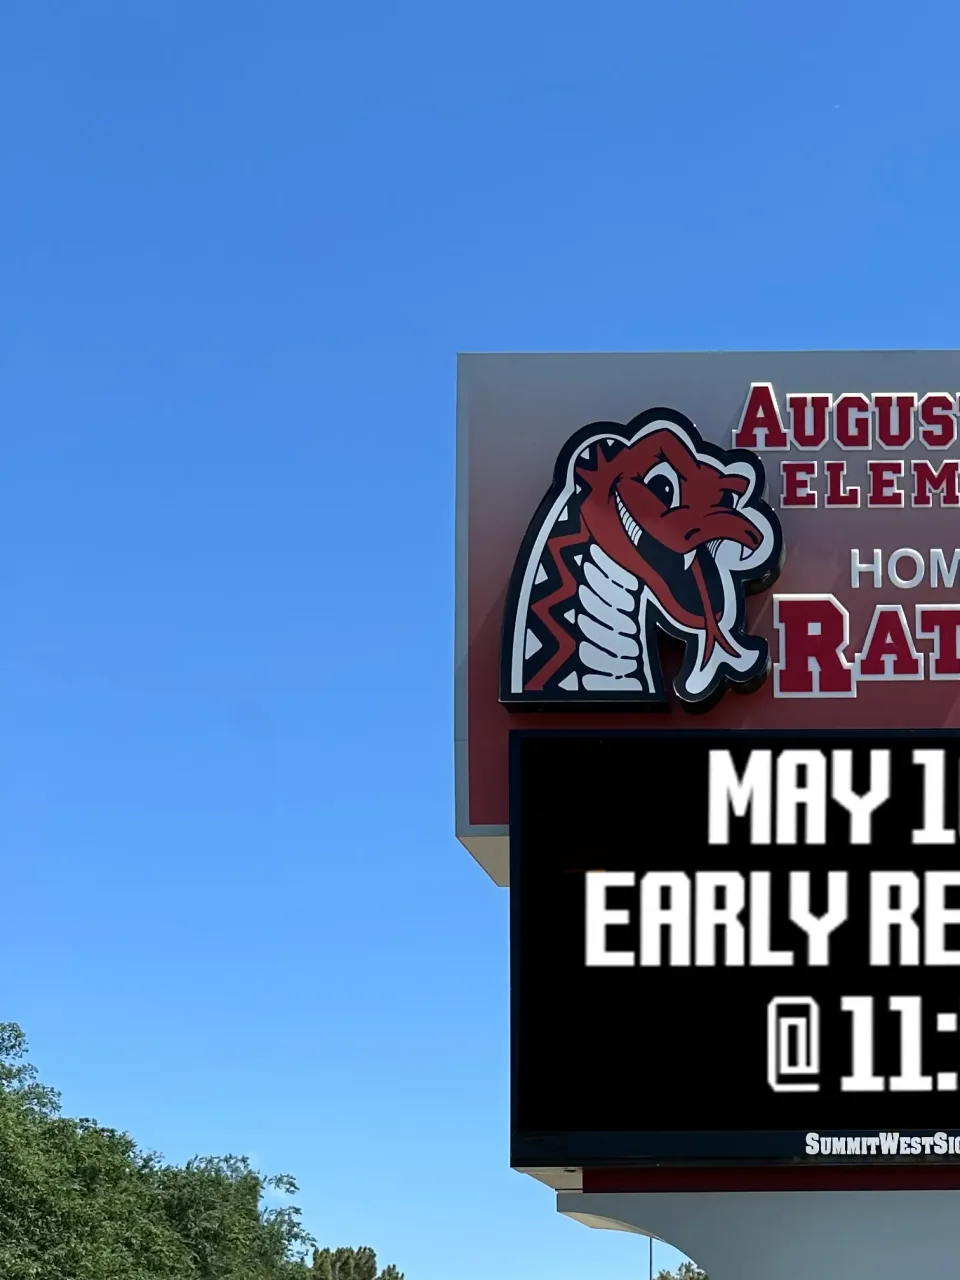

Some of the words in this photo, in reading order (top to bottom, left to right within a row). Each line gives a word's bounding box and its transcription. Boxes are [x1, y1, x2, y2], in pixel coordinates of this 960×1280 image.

[707, 748, 891, 845] MAY
[584, 870, 848, 967] EARLY
[767, 995, 820, 1092] @
